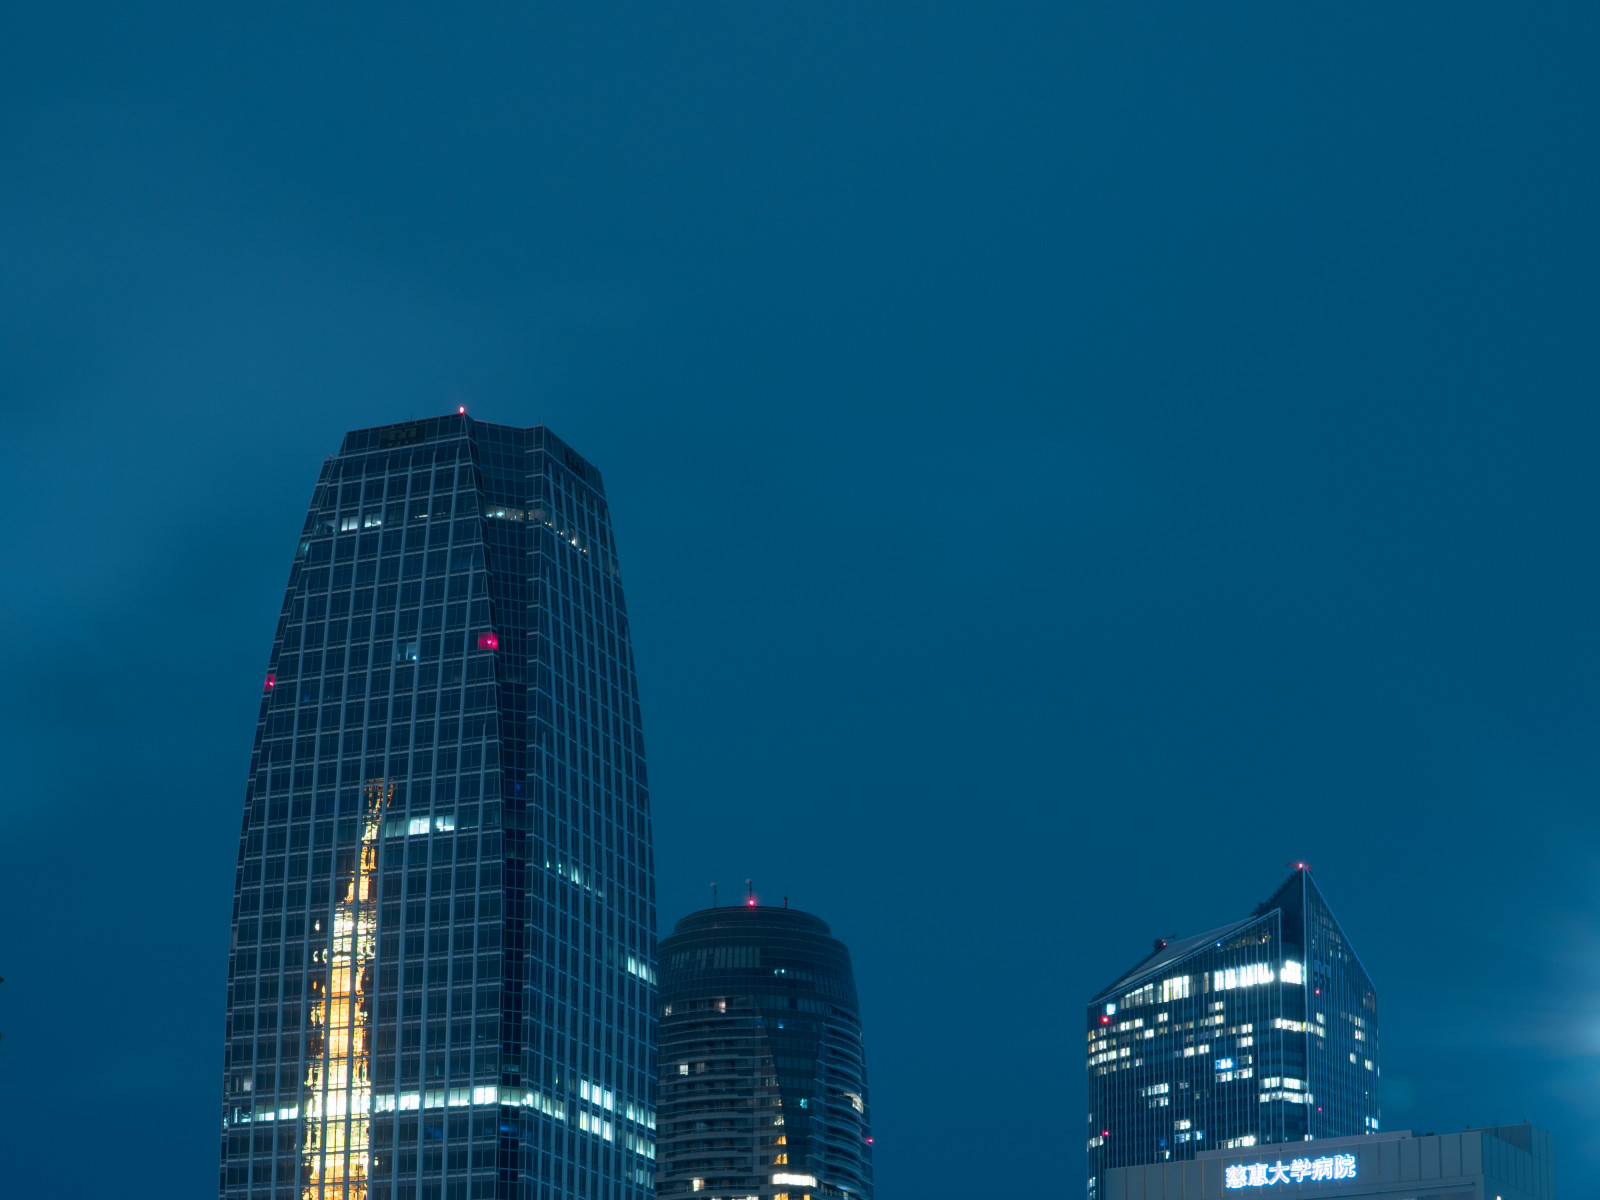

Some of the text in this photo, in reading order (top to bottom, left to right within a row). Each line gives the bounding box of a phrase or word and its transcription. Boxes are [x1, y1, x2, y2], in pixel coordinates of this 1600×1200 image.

[1225, 1154, 1356, 1189] 慈恵大学病院
